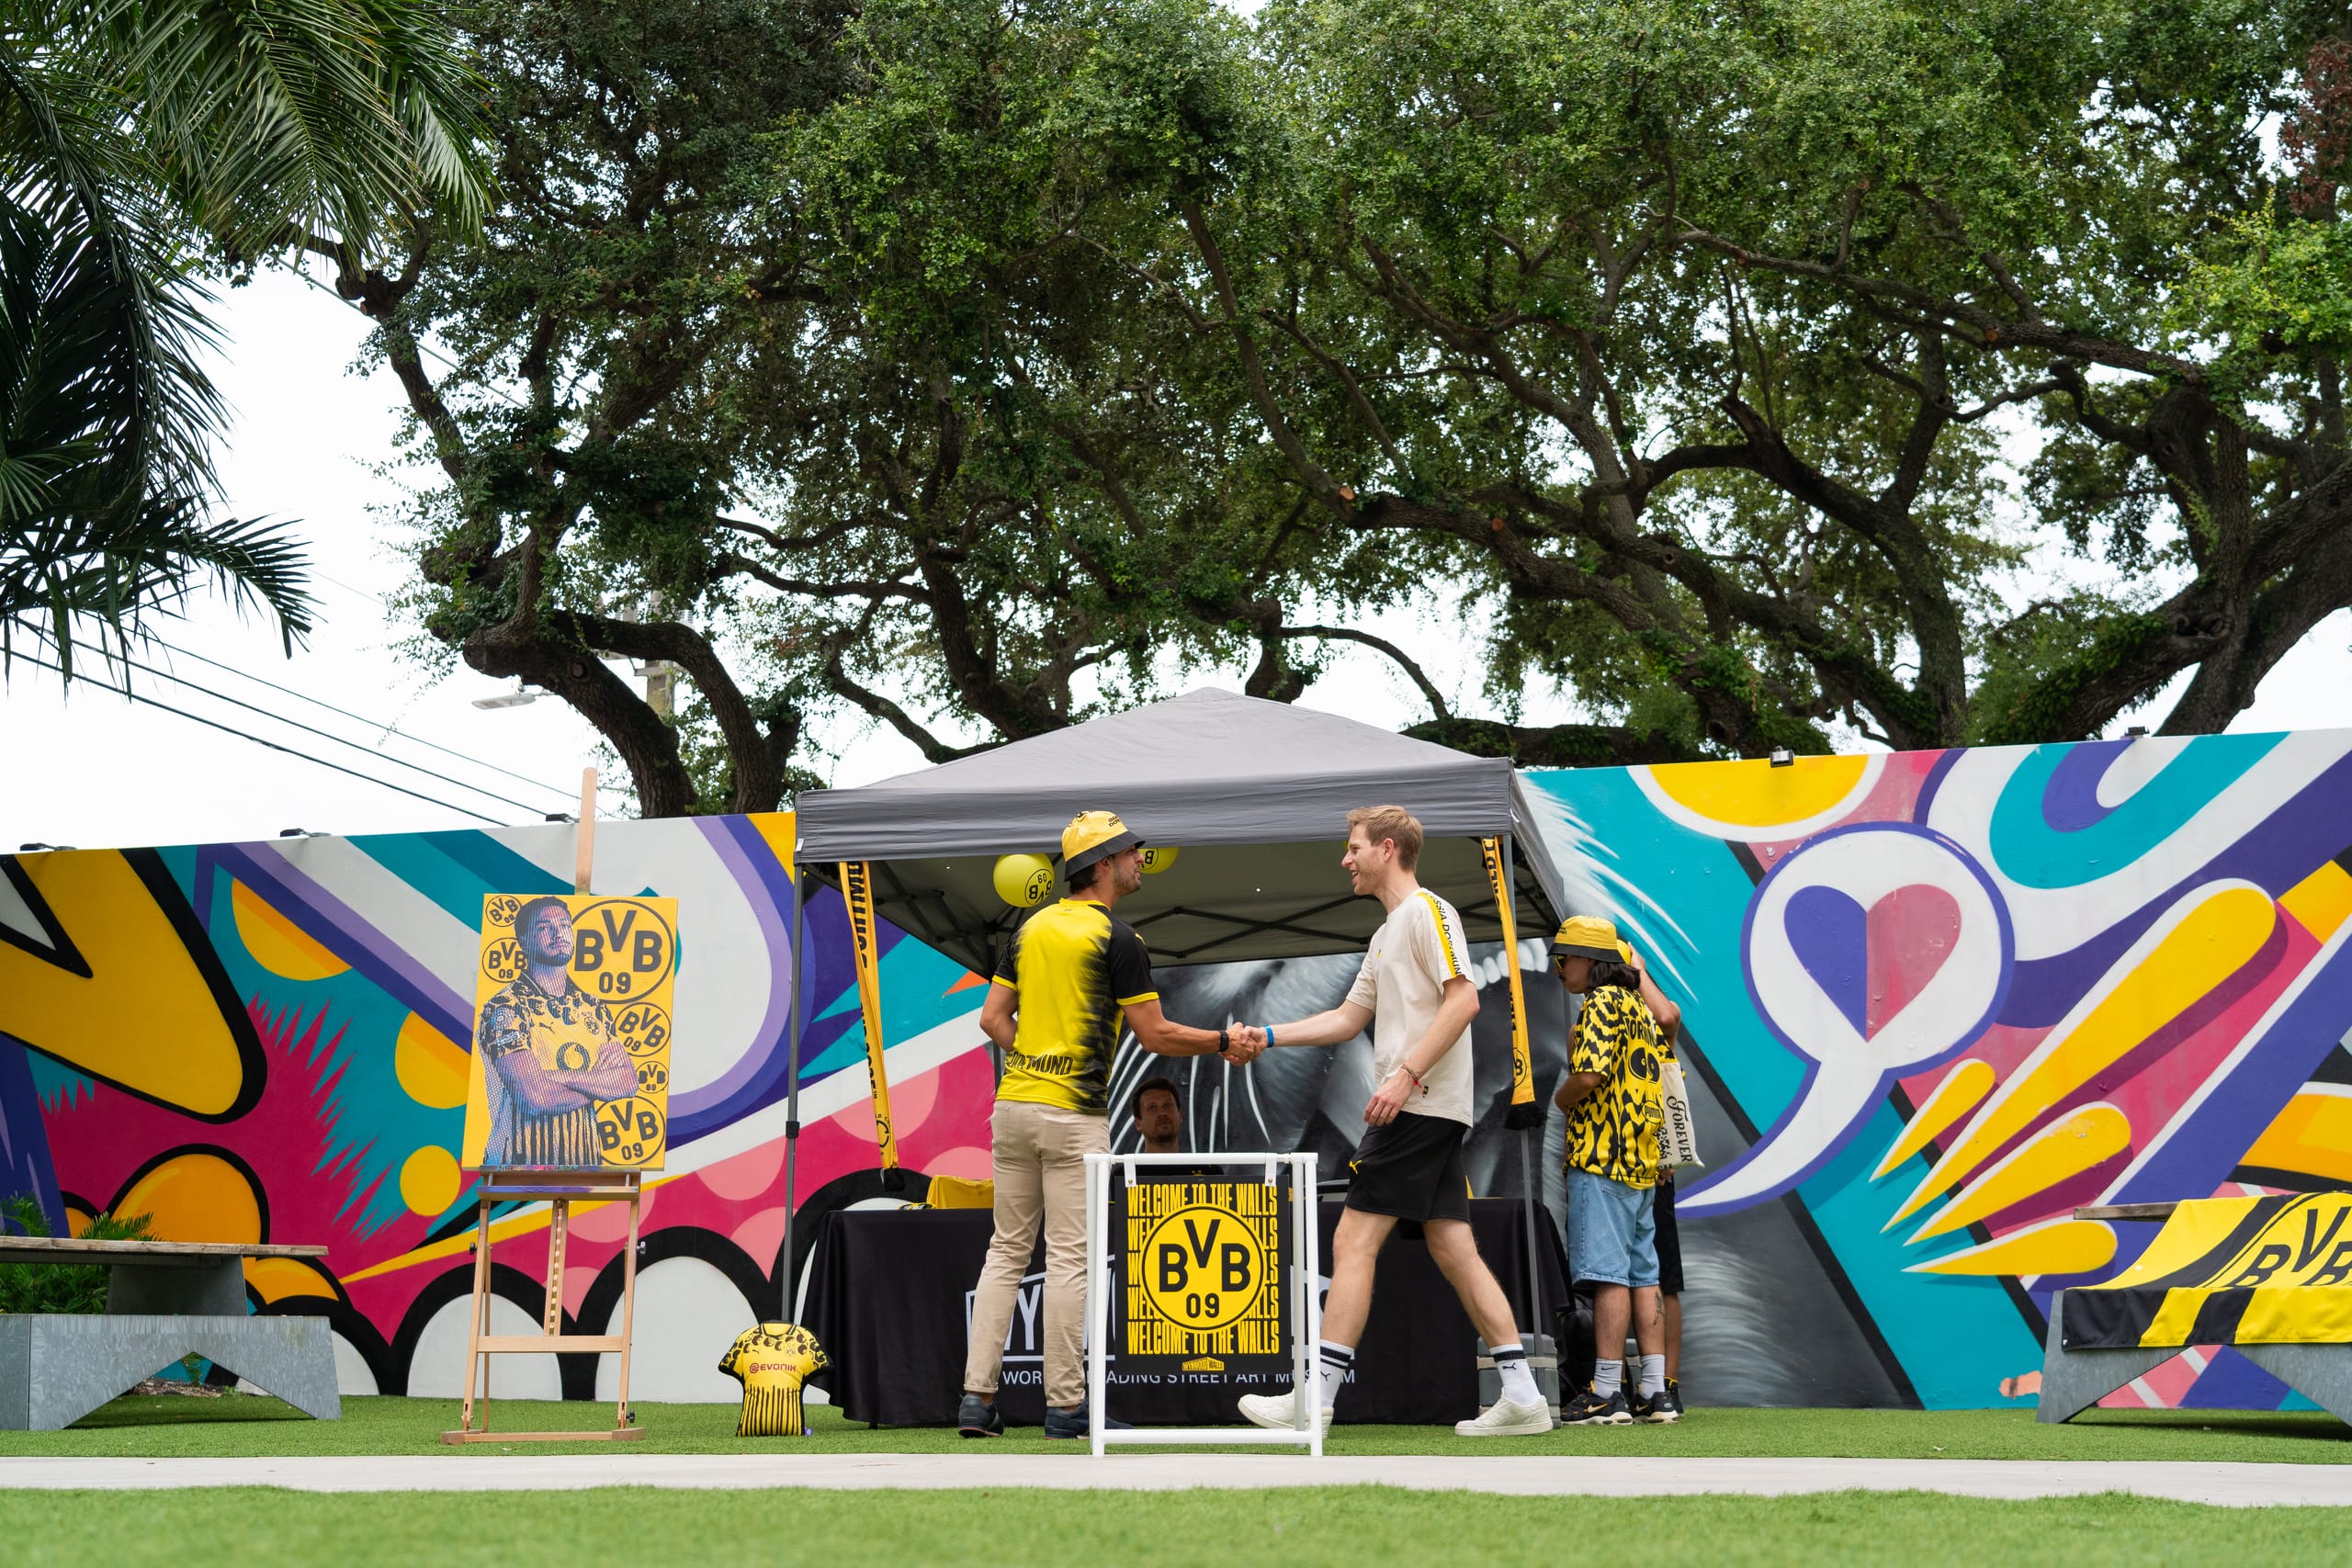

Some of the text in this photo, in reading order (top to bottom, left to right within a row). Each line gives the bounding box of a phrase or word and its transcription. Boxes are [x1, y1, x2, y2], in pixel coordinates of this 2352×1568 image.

[490, 897, 519, 922] BVB
[503, 914, 515, 924] 09
[574, 909, 662, 972] BVB
[489, 942, 527, 969] BVB
[499, 968, 514, 979] 09
[598, 971, 631, 995] 09
[618, 1007, 666, 1048] BVB
[623, 1035, 642, 1052] 09
[639, 1064, 666, 1084] BVB
[599, 1100, 659, 1151] BVB
[1667, 1096, 1693, 1162] FOREVER
[621, 1142, 644, 1161] 09
[1127, 1184, 1278, 1217] WELCOME TO THE WALLS
[1159, 1219, 1250, 1292] BVB
[1186, 1293, 1220, 1318] 09
[1127, 1320, 1279, 1355] WELCOME TO THE WALLS
[761, 1364, 797, 1372] EVONIK
